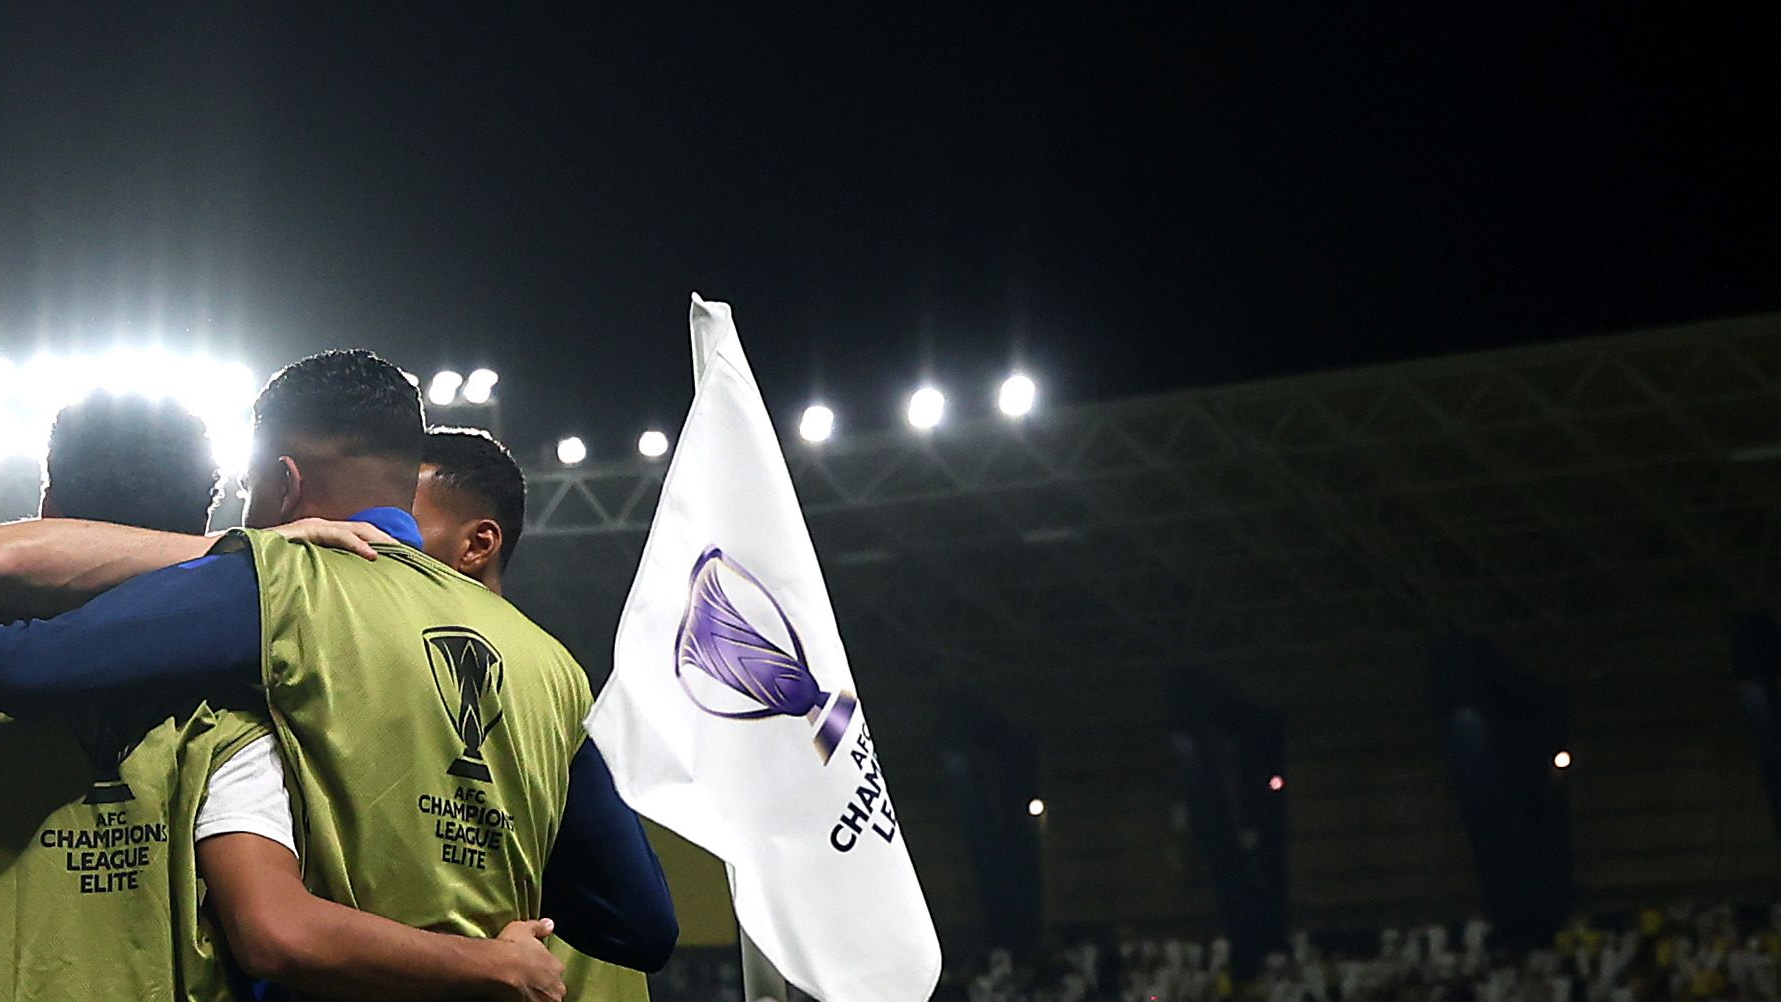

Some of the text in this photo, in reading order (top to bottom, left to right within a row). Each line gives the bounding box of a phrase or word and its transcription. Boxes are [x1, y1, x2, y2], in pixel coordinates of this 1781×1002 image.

[453, 785, 487, 805] AFC
[829, 757, 882, 853] CHAM
[95, 811, 127, 828] AFC
[418, 794, 515, 832] CHAMPIONS
[871, 799, 896, 844] LE
[40, 823, 168, 849] CHAMPIONS
[435, 819, 503, 850] LEAGUE
[66, 846, 150, 871] LEAGUE
[441, 843, 487, 870] ELITE
[80, 870, 139, 893] ELITE
